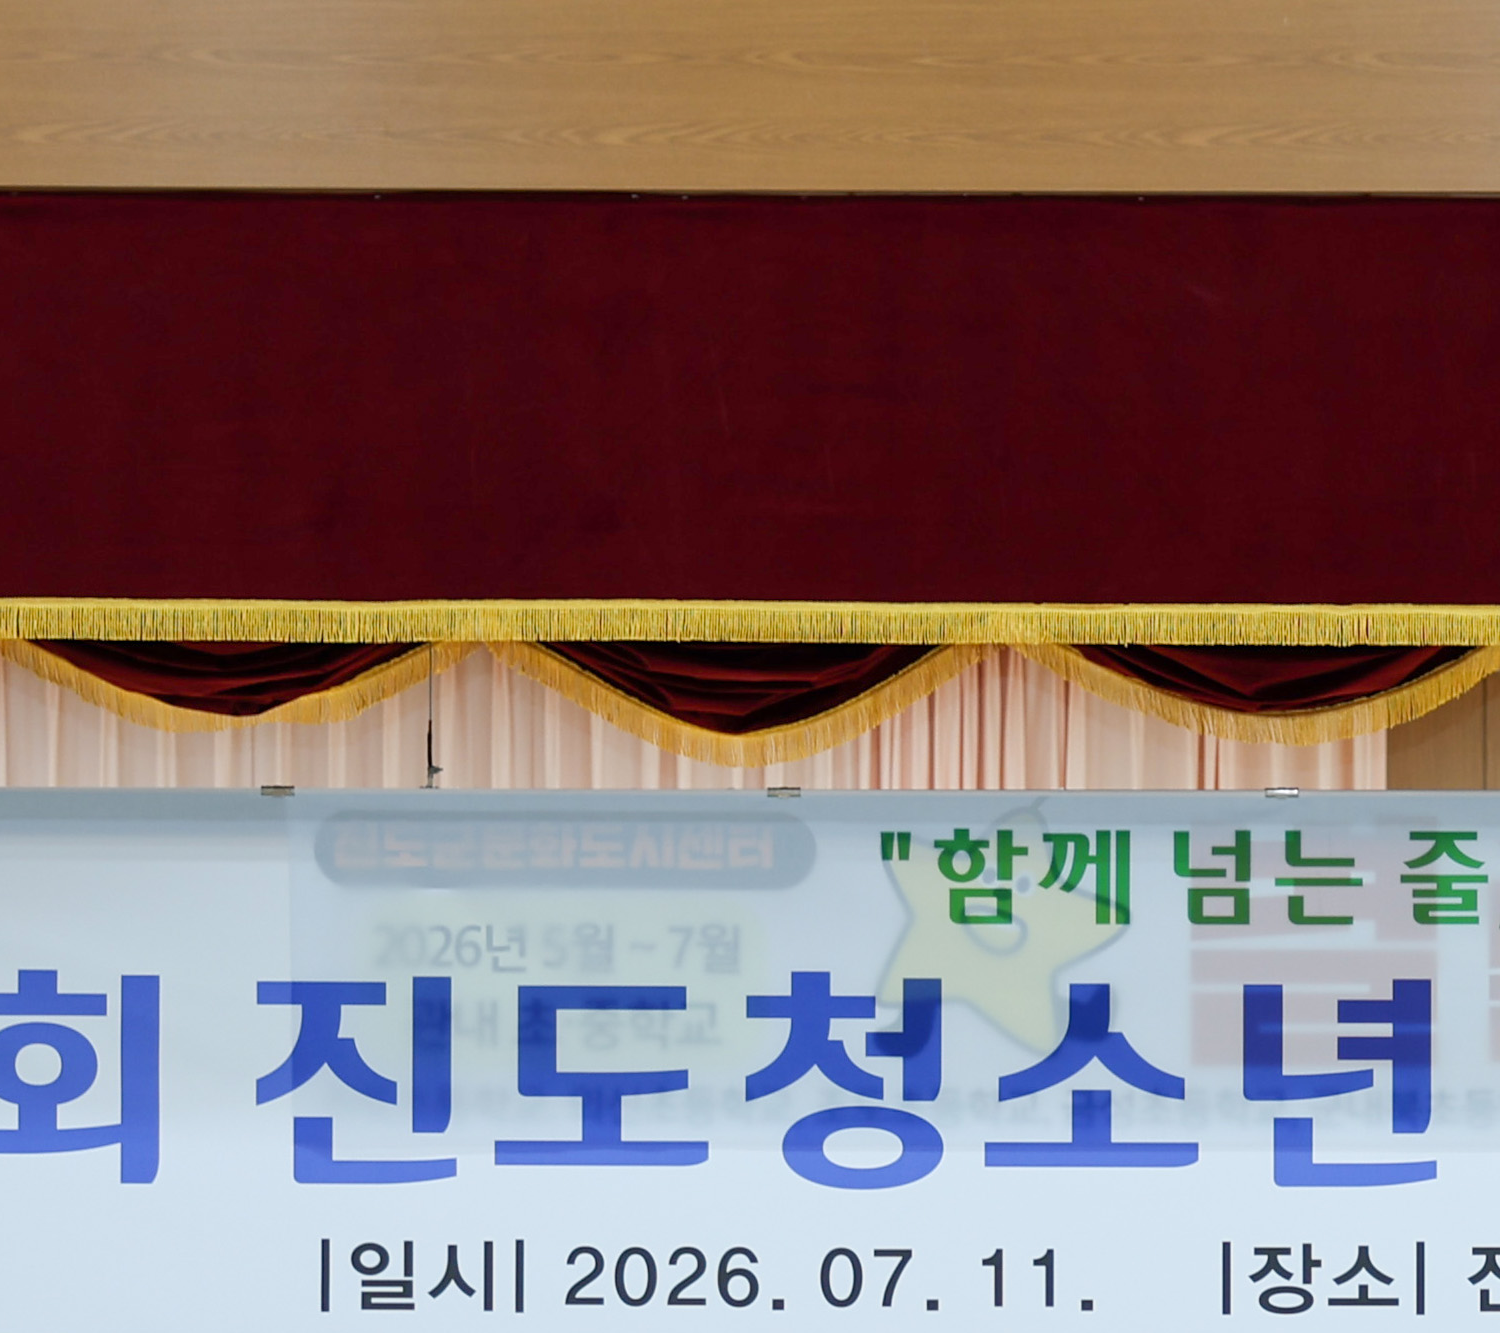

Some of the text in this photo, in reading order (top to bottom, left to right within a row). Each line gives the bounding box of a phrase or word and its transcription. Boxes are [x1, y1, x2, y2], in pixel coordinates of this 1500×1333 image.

[881, 829, 1132, 926] "함께
[1175, 831, 1364, 925] 넘는
[256, 971, 1439, 1190] 진도청소년
[565, 1246, 787, 1312] 2026.
[820, 1247, 941, 1312] 07.
[982, 1248, 1096, 1312] 11.
